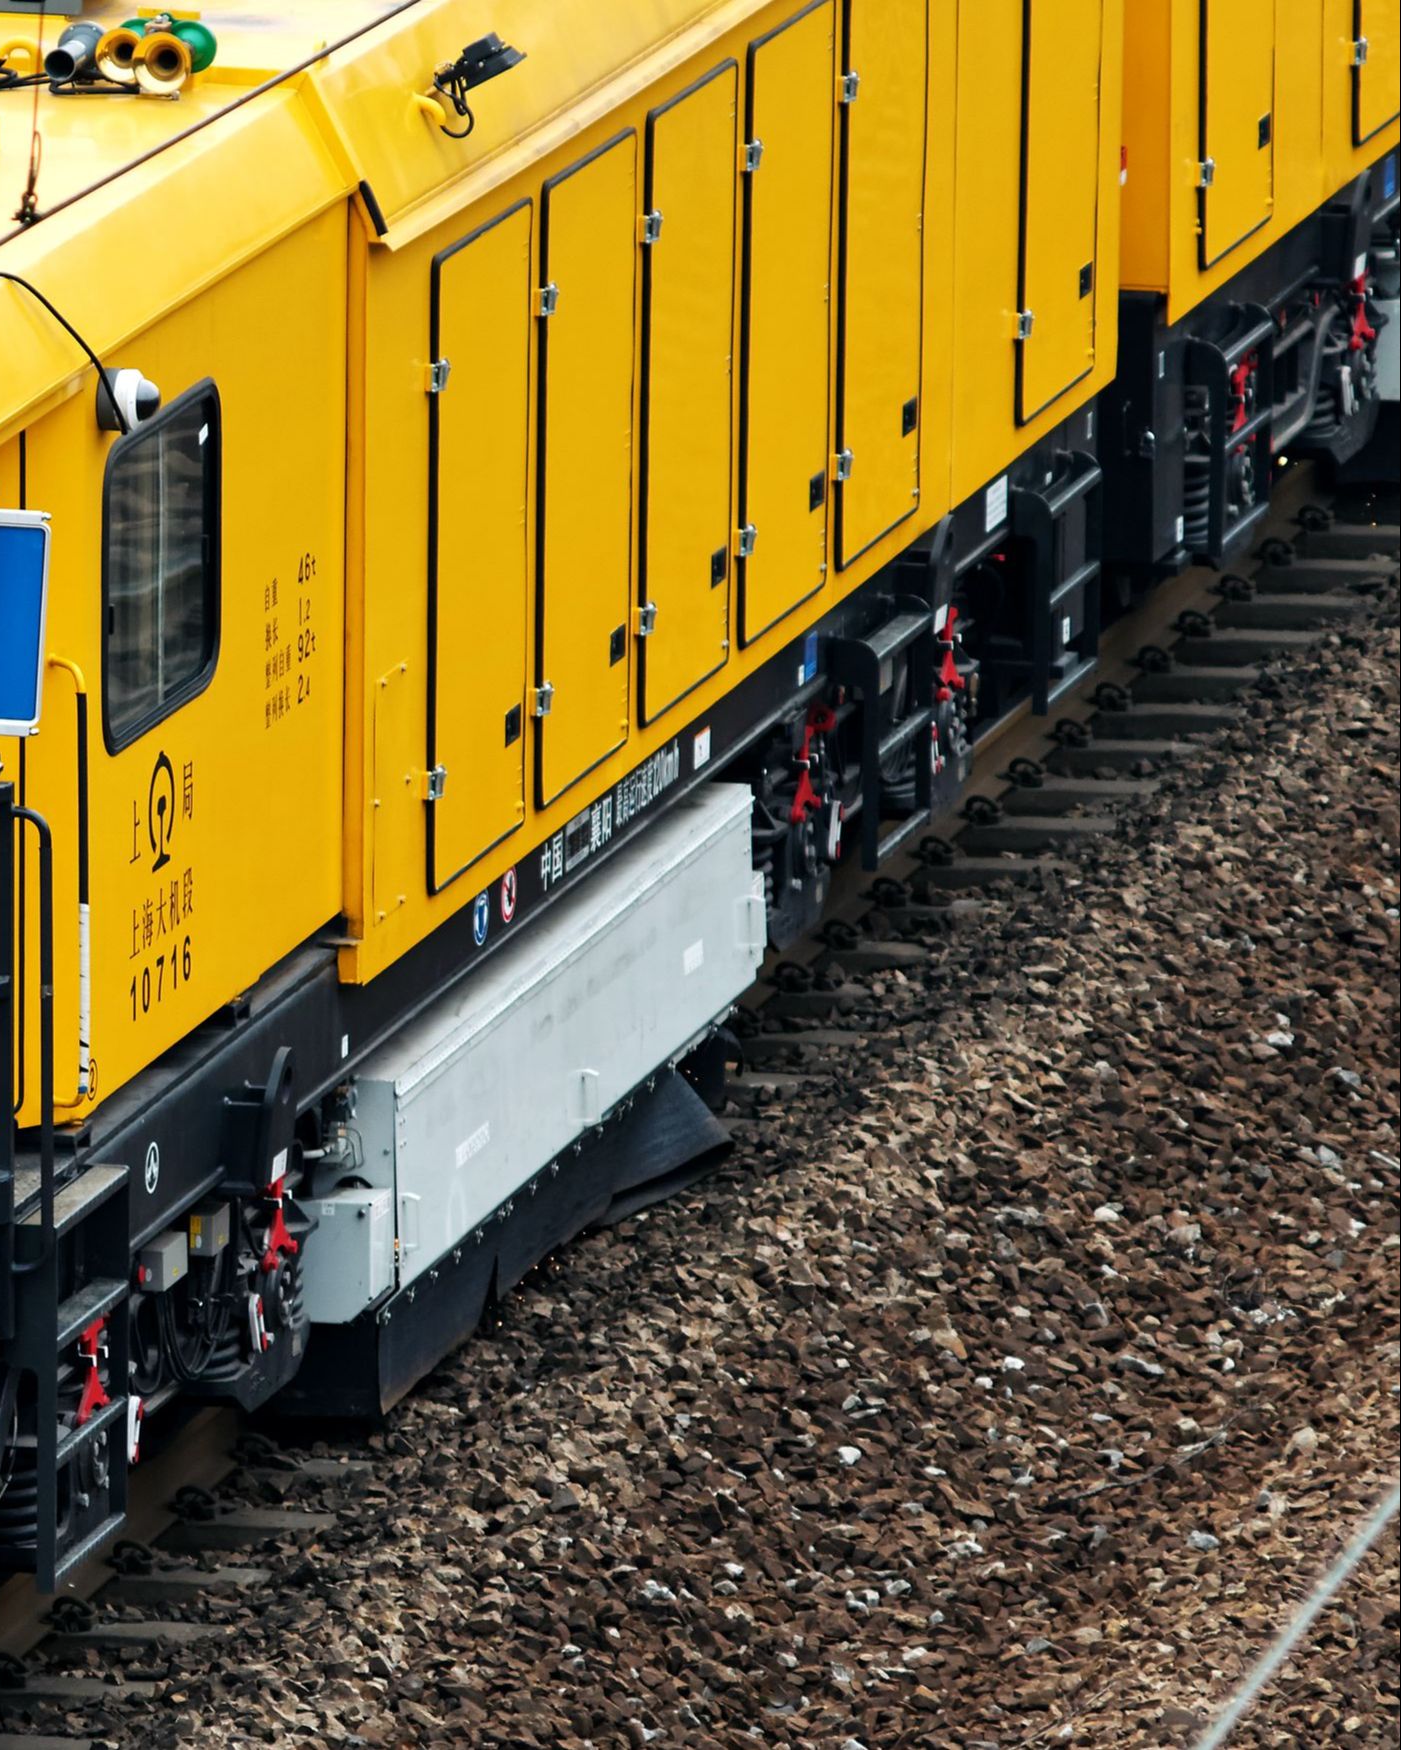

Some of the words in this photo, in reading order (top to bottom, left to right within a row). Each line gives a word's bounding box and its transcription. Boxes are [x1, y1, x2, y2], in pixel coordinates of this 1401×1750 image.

[298, 552, 316, 585] 46t
[298, 628, 316, 663] 92t
[129, 800, 141, 864] 上
[182, 761, 193, 823] 局
[541, 831, 563, 891] 中国
[129, 867, 193, 960] 上海大机段
[130, 935, 191, 1021] 10716
